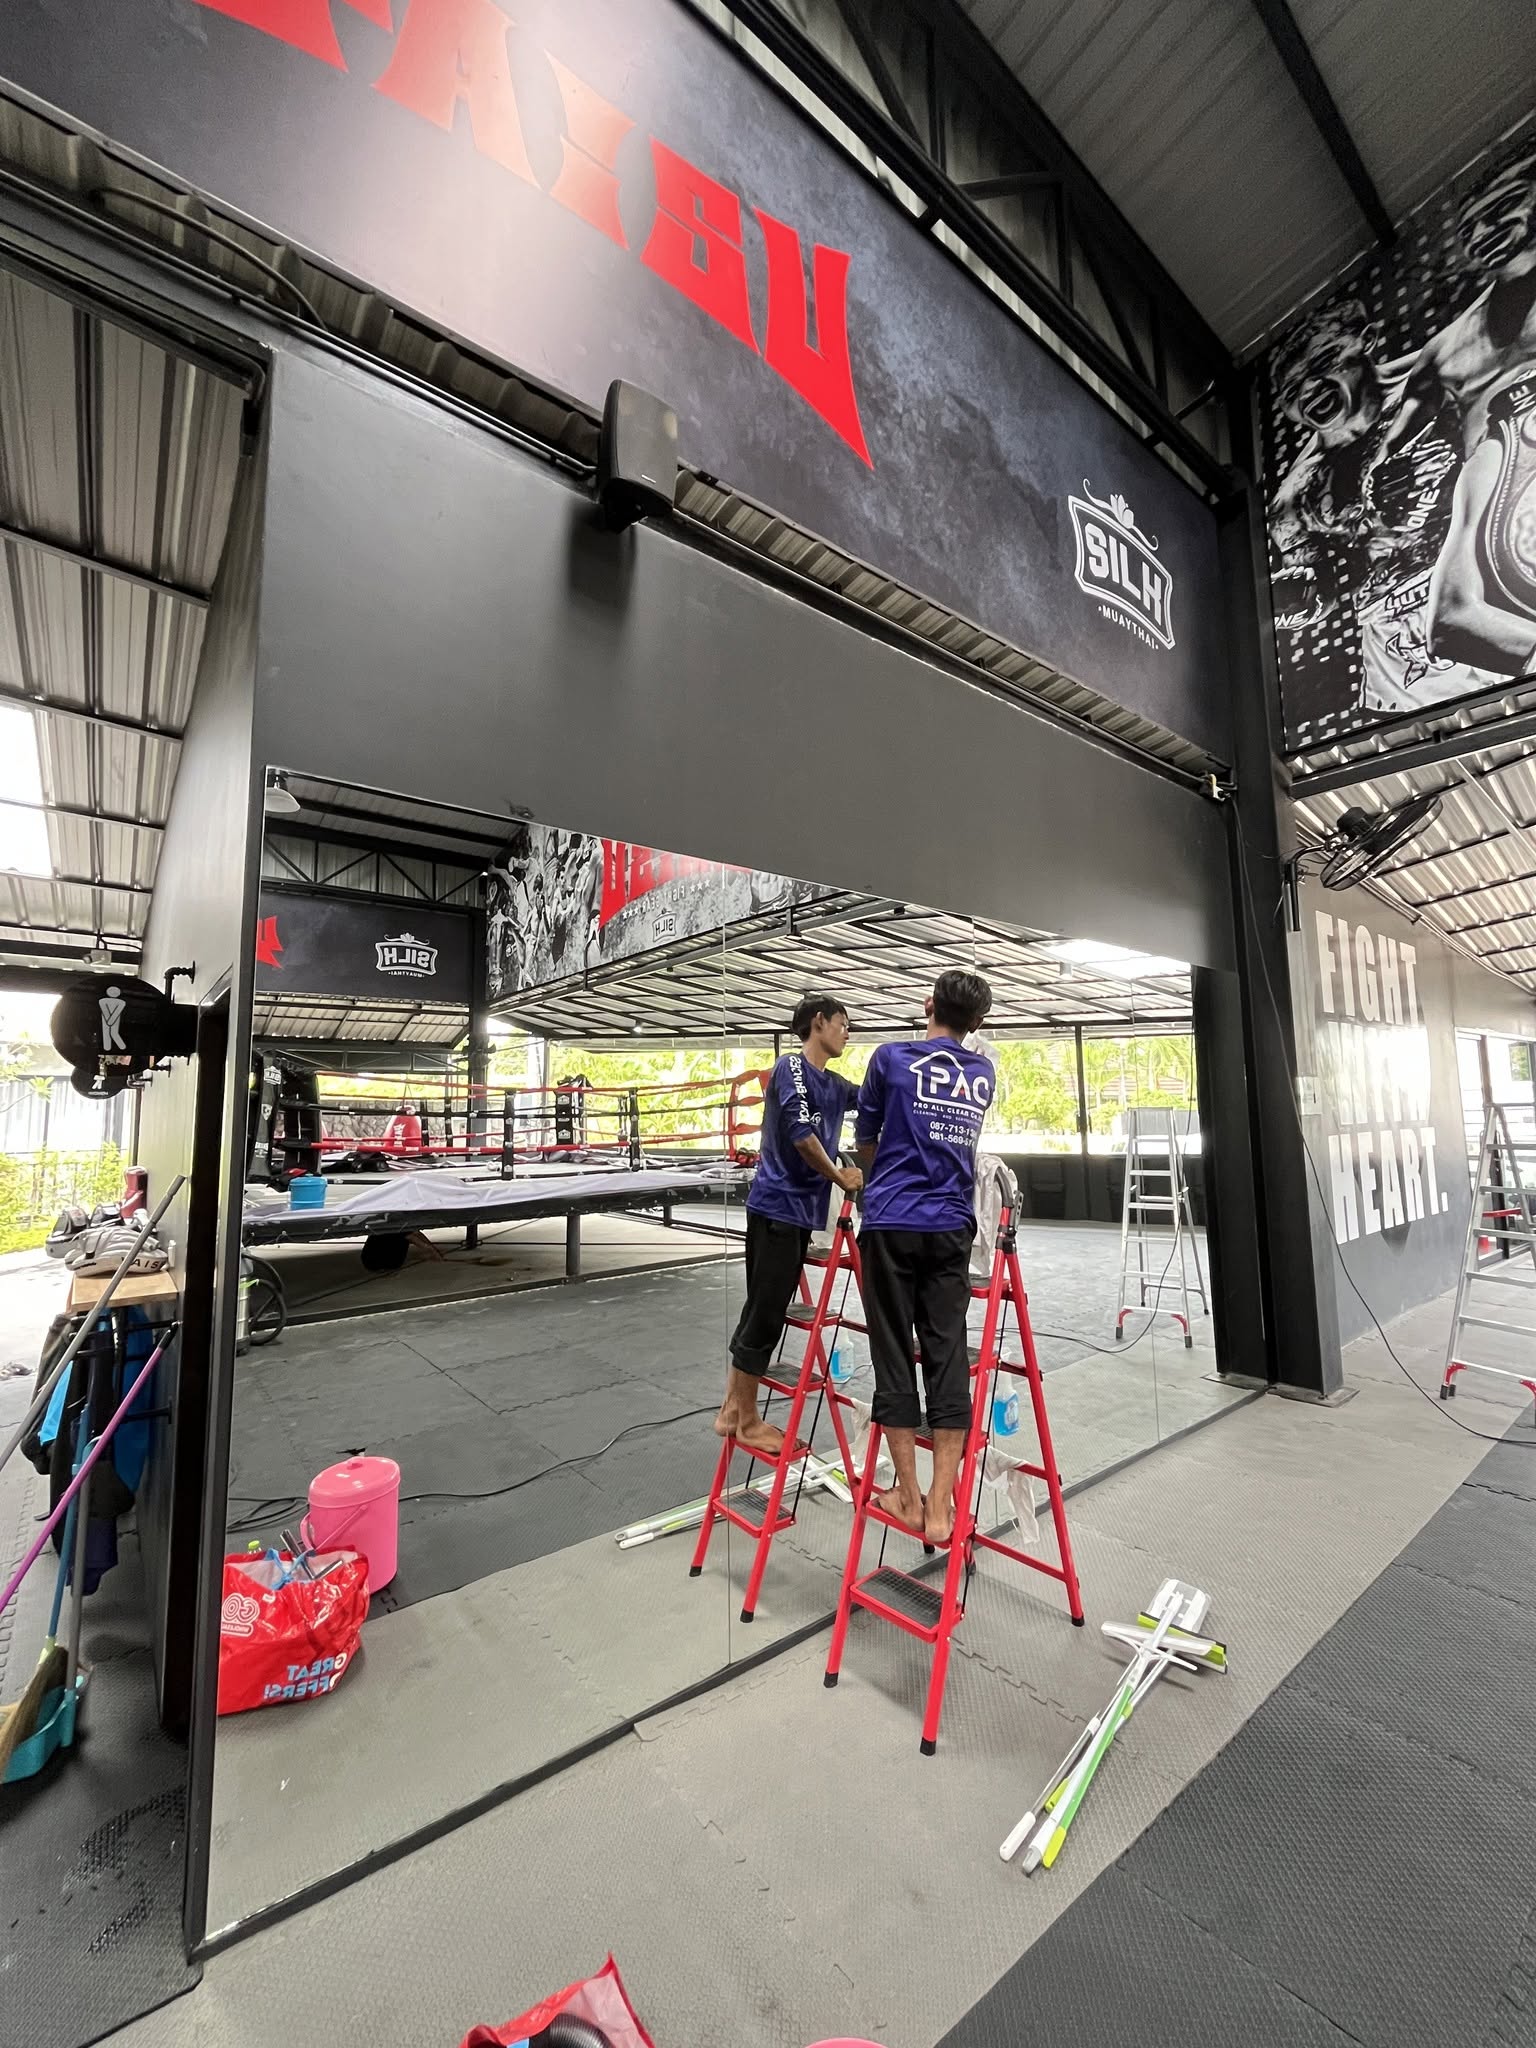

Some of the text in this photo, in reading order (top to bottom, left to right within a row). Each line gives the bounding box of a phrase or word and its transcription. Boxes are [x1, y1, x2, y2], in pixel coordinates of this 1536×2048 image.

[187, 0, 874, 470] AISU
[1407, 489, 1441, 527] ONE
[1101, 605, 1156, 649] MUAYTHAI
[1315, 910, 1418, 1025] FIGHT
[913, 1101, 928, 1110] PRO
[931, 1104, 944, 1112] ALL
[930, 1066, 989, 1107] PAC
[1328, 1126, 1449, 1245] HEART.
[121, 1257, 159, 1269] AIS
